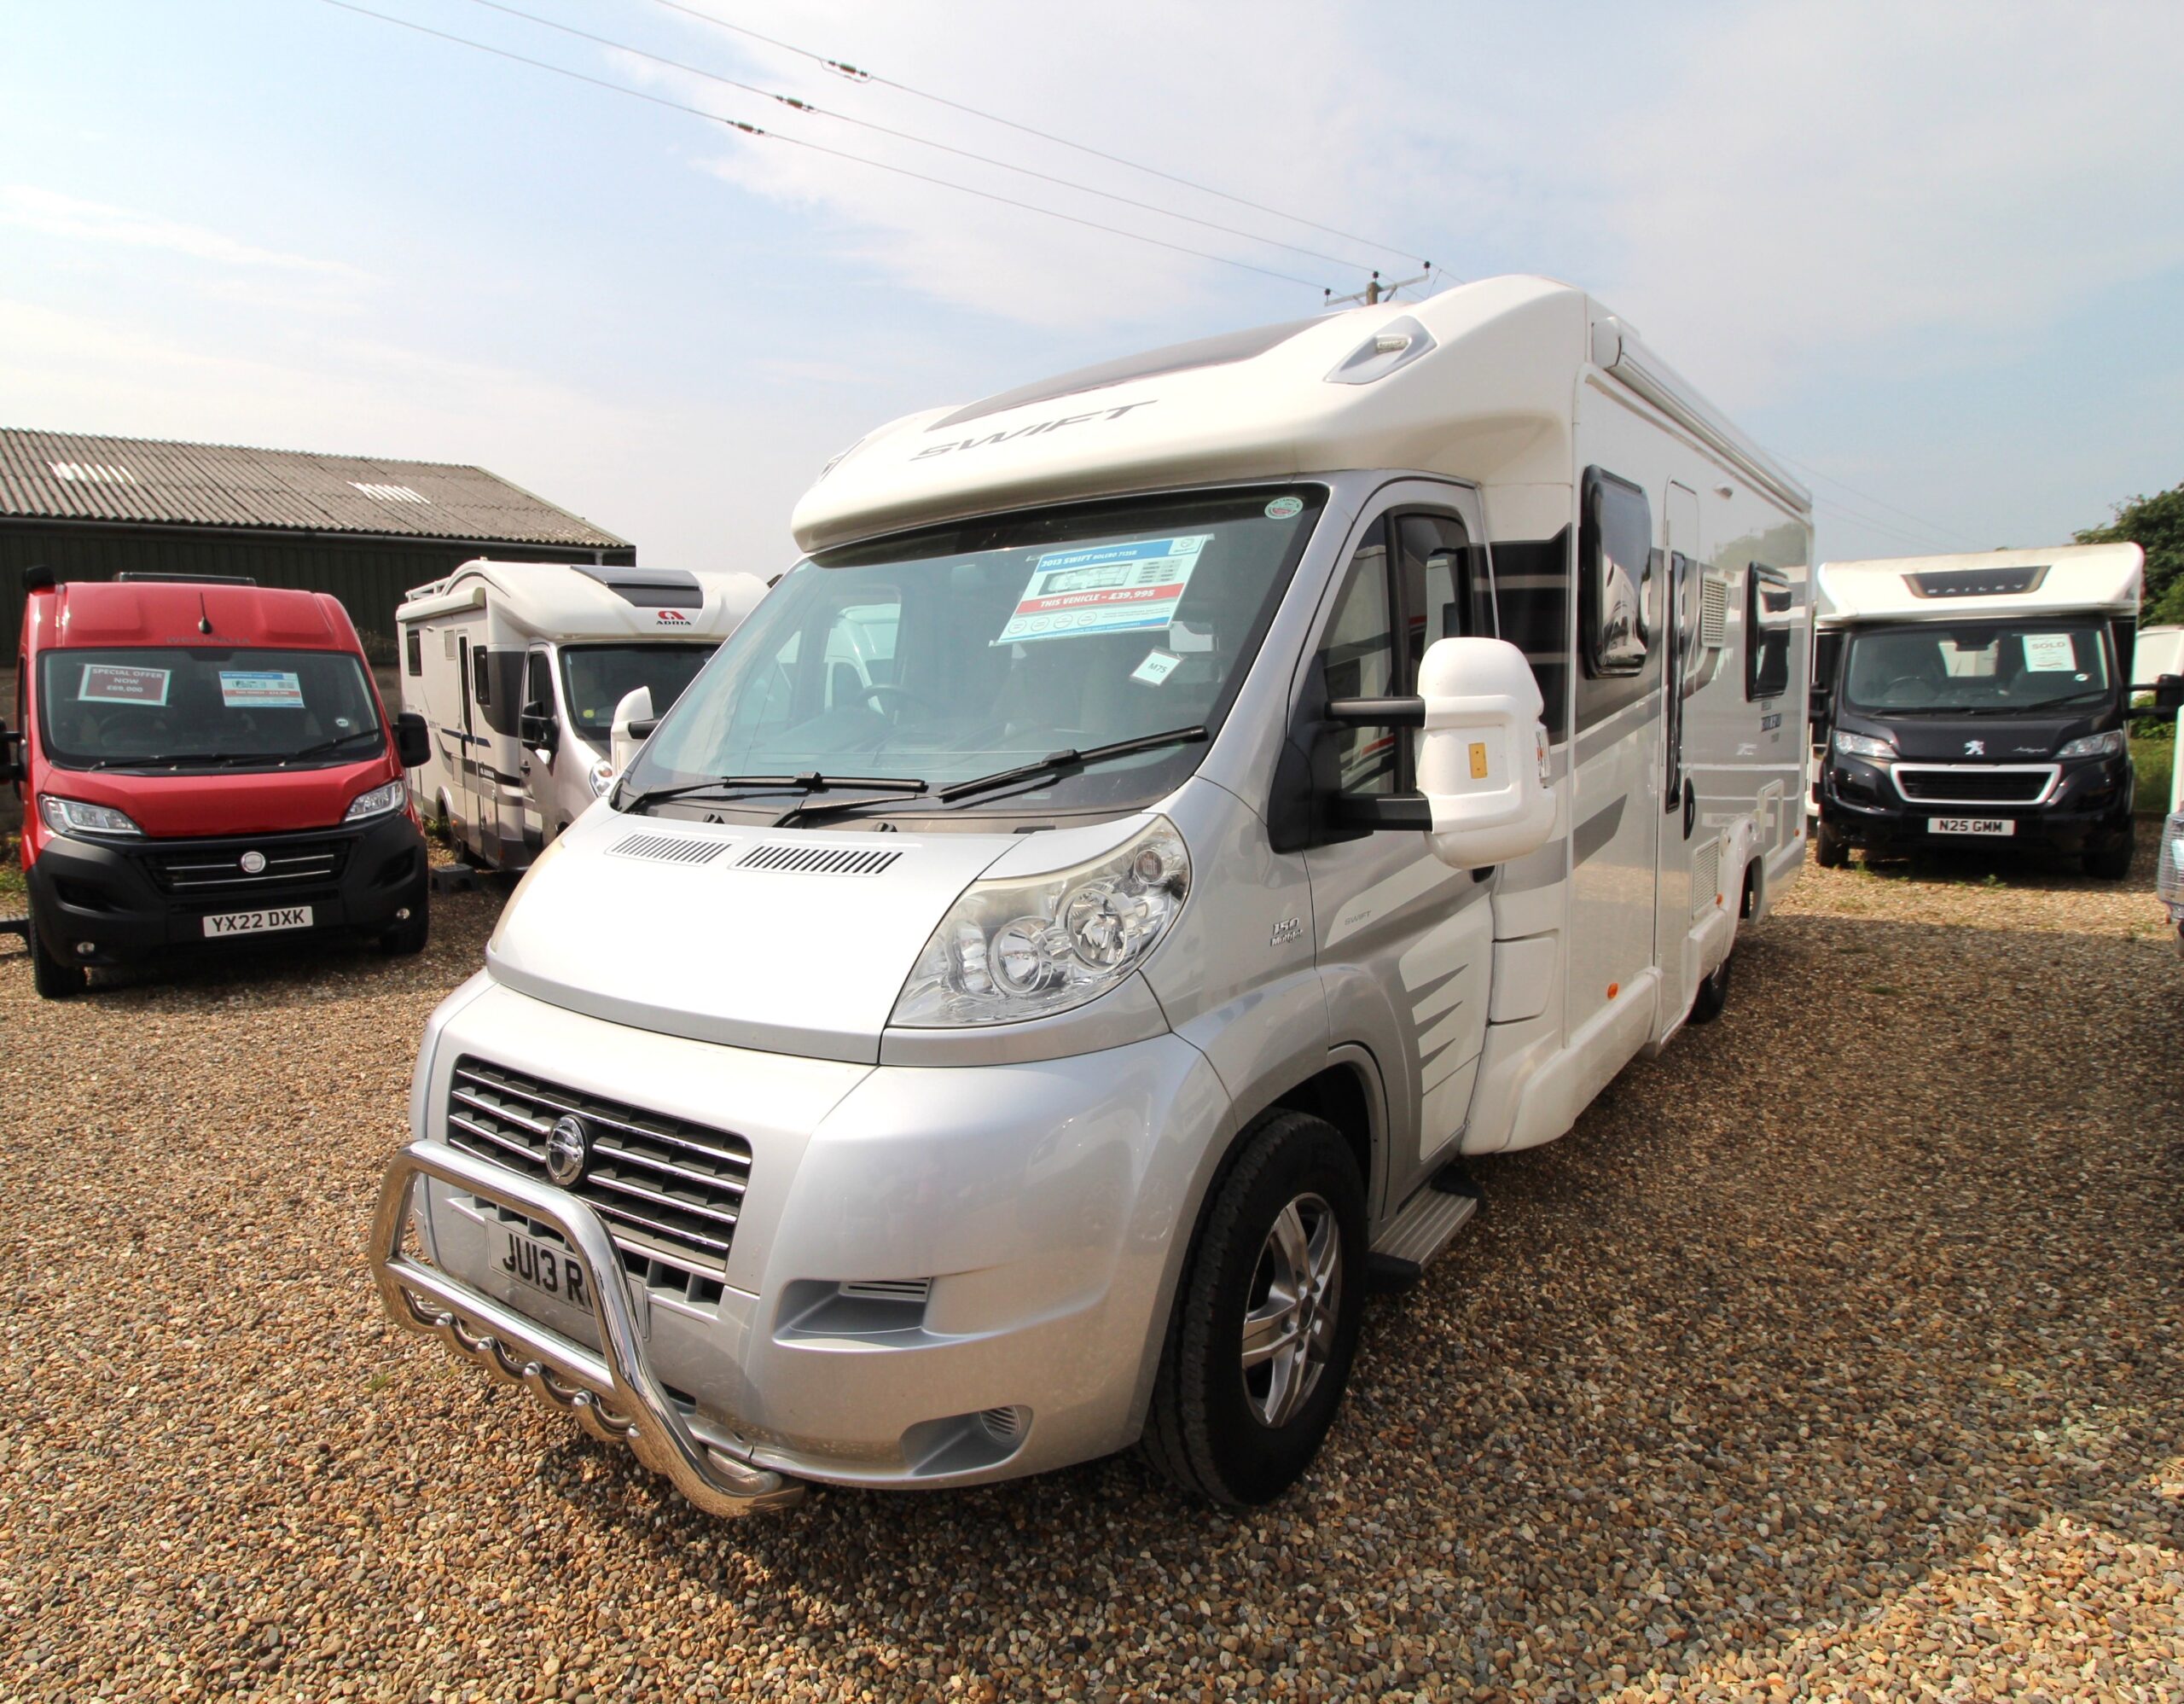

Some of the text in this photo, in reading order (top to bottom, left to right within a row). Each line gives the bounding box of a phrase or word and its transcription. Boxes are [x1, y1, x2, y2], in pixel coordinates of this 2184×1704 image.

[909, 398, 1159, 462] SWIFT
[1063, 554, 1093, 564] SWIFT
[1926, 583, 2025, 595] BAILEY
[1040, 598, 1060, 609] THIS
[1063, 593, 1100, 605] VEHICLE
[2031, 641, 2066, 650] SOLD
[92, 668, 163, 679] SPECIAL OFFER
[1147, 661, 1168, 675] M75
[1938, 819, 2003, 832] N25 GMM
[212, 908, 305, 933] YX22 DXK
[1344, 910, 1372, 926] SWIFT
[1272, 917, 1300, 936] 150
[502, 1232, 594, 1311] JU13 R
